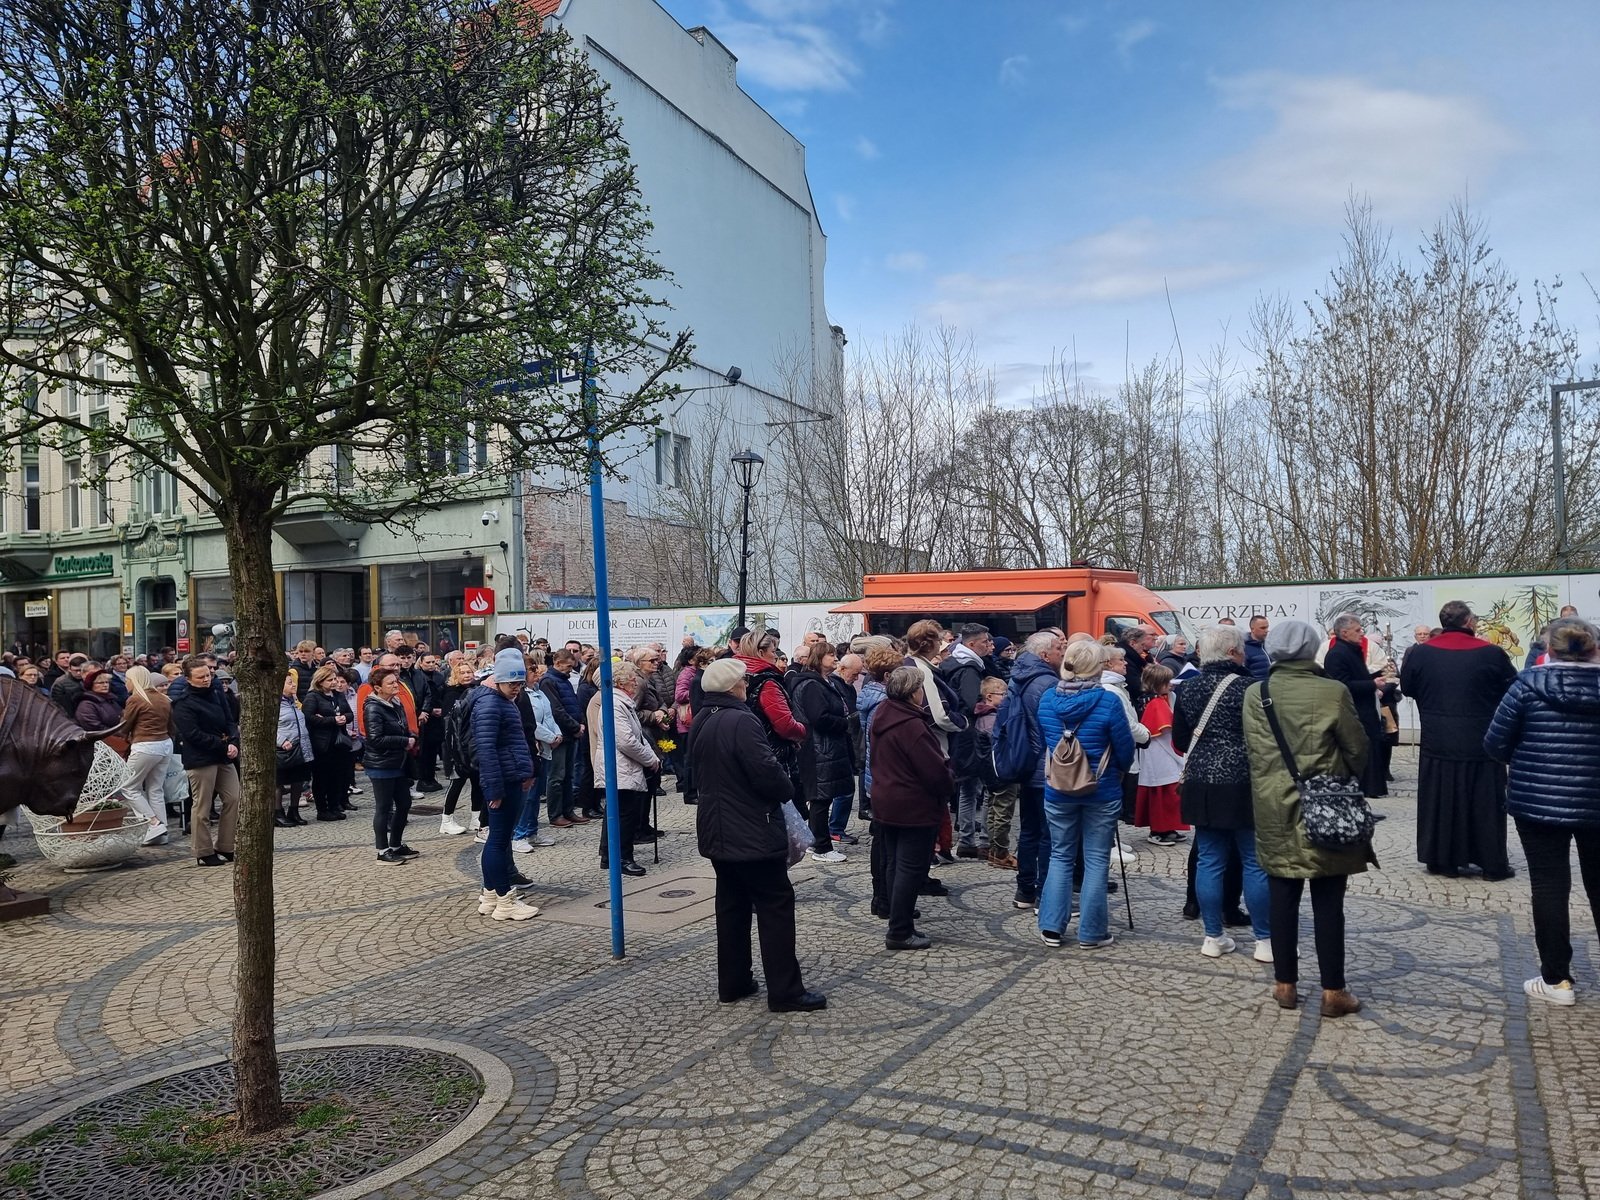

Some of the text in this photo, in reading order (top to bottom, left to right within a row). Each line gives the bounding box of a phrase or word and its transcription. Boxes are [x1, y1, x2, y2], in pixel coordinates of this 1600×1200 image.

[54, 553, 113, 572] Karkonoska
[1181, 603, 1298, 620] ICZYRZEPA?
[568, 619, 595, 630] DUCH
[627, 617, 668, 629] GENEZA
